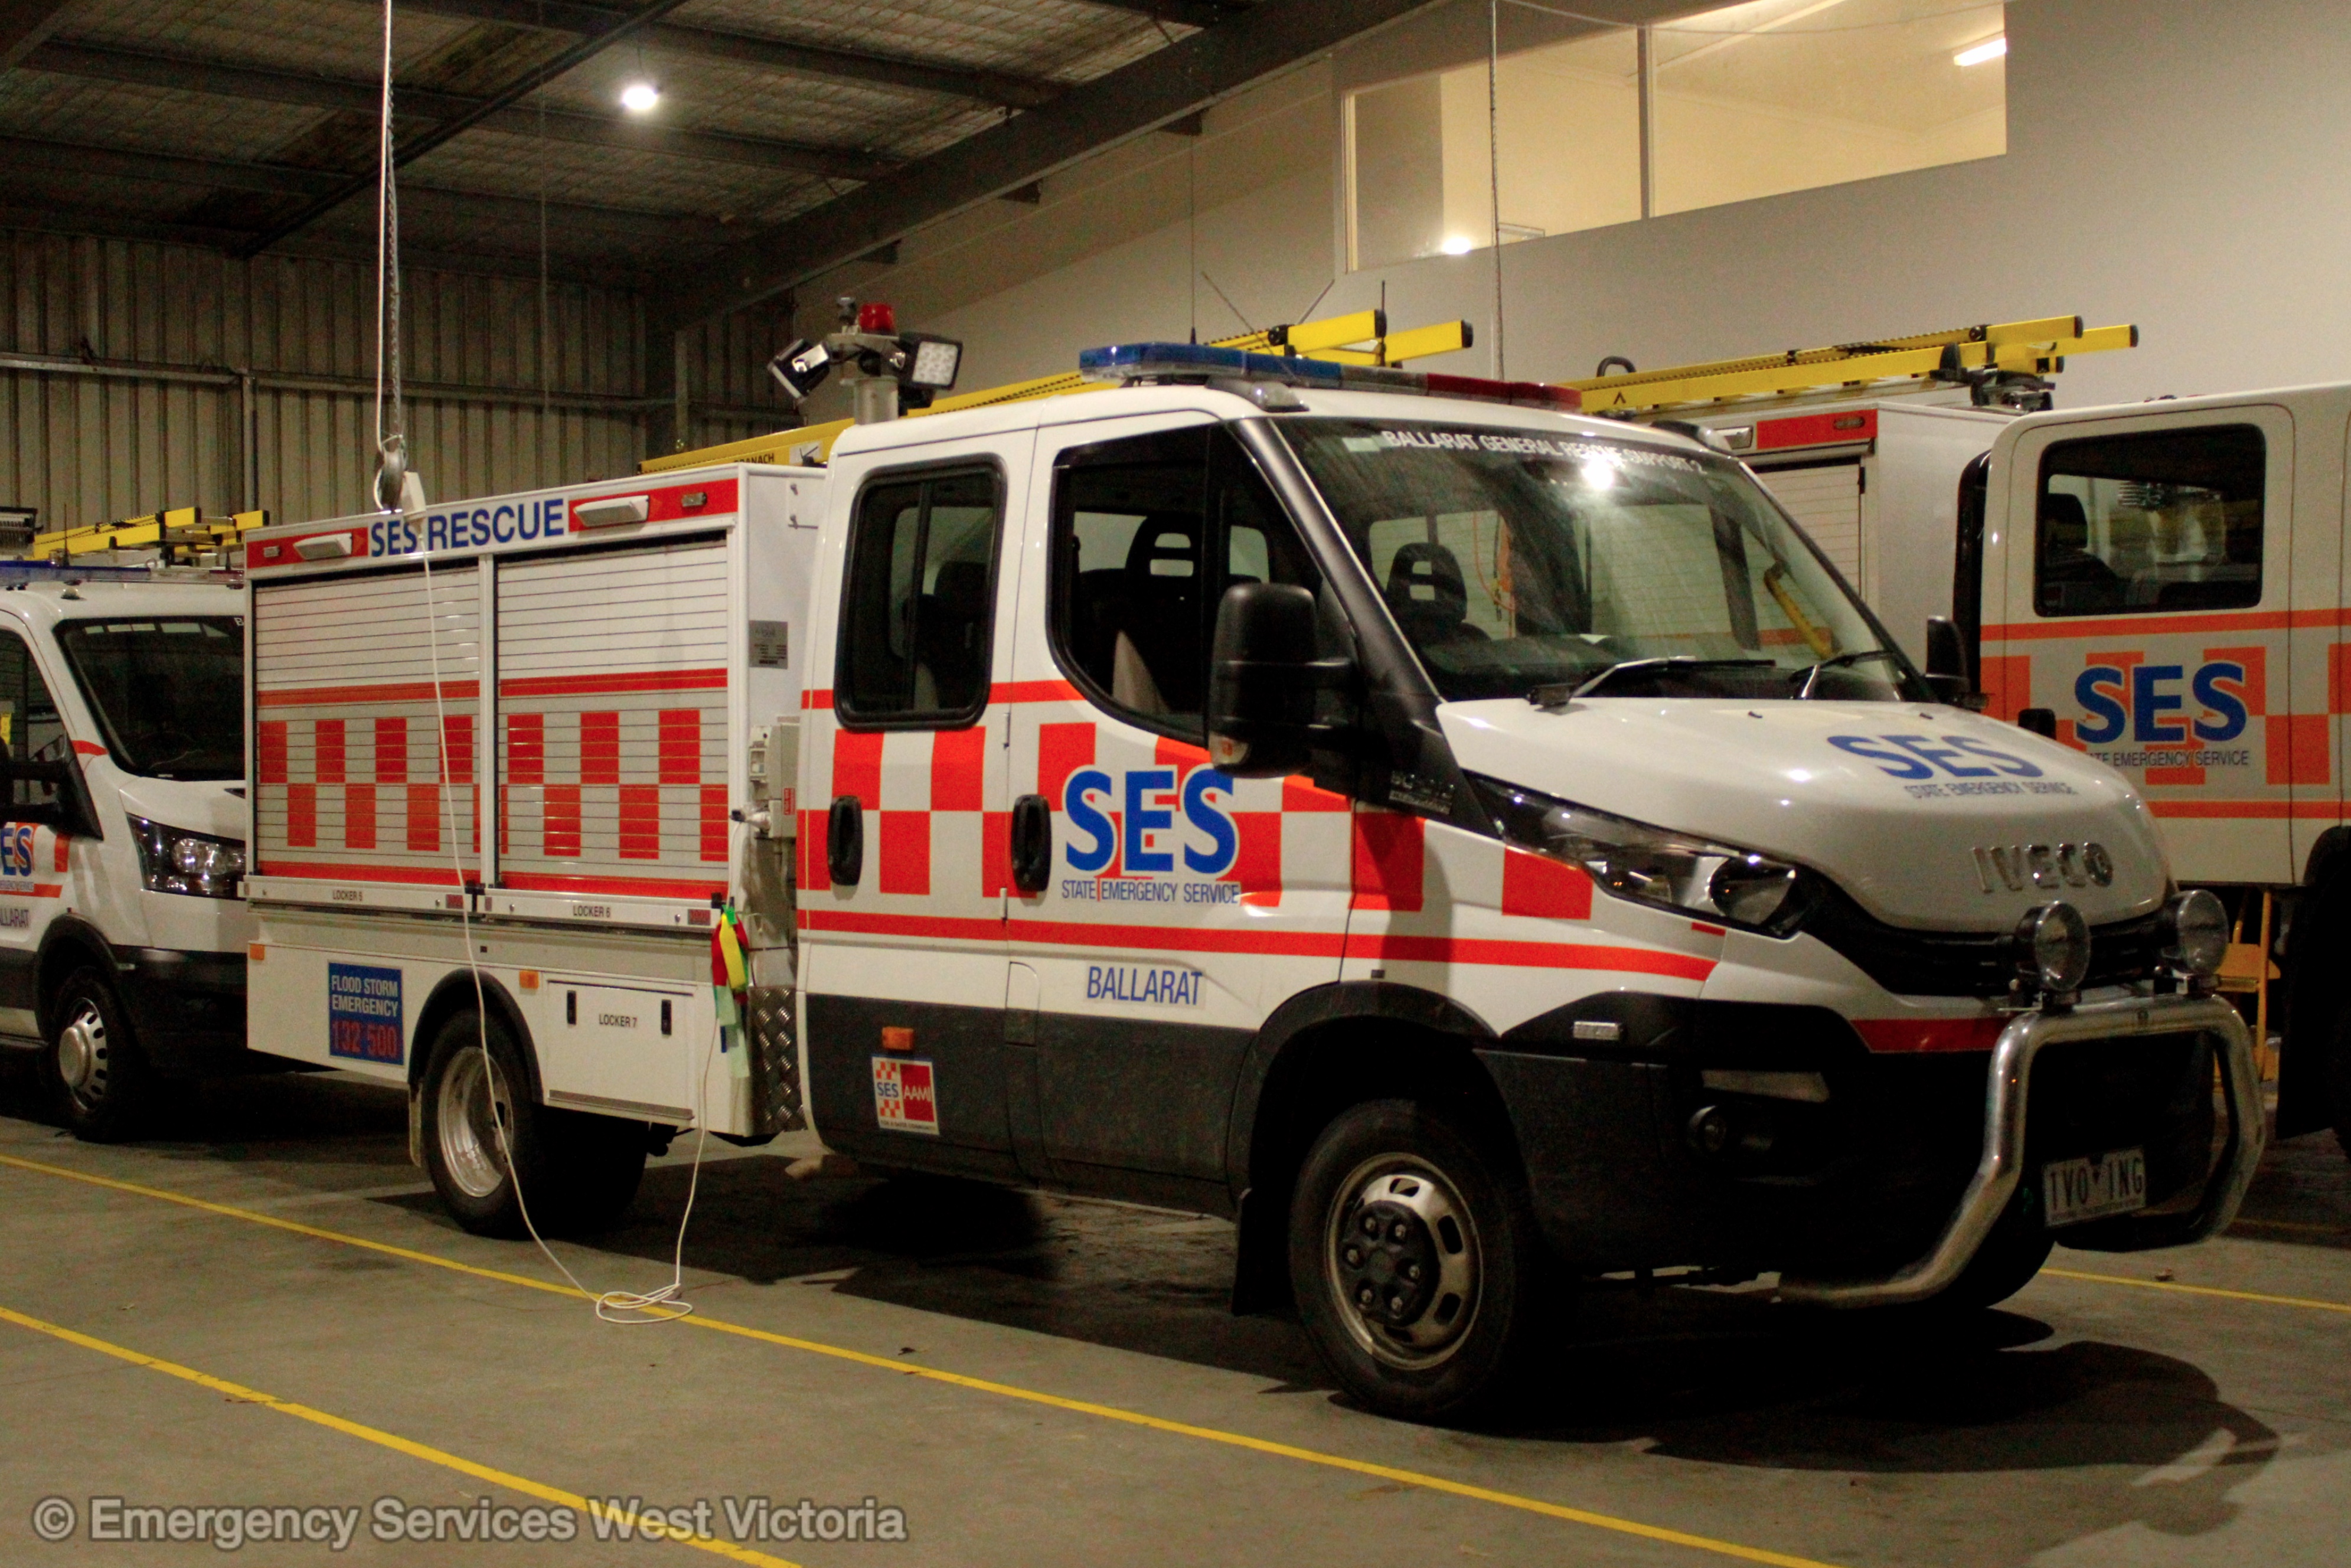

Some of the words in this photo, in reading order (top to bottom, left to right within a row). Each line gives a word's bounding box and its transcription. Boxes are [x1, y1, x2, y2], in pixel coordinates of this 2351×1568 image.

[734, 452, 775, 464] ANACH
[1380, 430, 1479, 451] BALLARAT
[1478, 435, 1564, 456] GENERAL
[1557, 442, 1626, 468] RESCUE
[1622, 449, 1694, 472] SUPPORT
[371, 520, 417, 557] SES
[427, 498, 564, 551] RESCUE
[2075, 662, 2247, 744] SES
[1826, 734, 2044, 779] SES
[2113, 751, 2191, 767] EMERGENCY
[2195, 750, 2250, 766] SERVICE
[1065, 769, 1236, 874] SES
[0, 827, 32, 877] ES
[1970, 842, 2114, 894] IVECO
[332, 890, 357, 901] LOCKER
[1062, 879, 1096, 900] STATE
[1101, 880, 1178, 902] EMERGENCY
[1183, 882, 1239, 904] SERVICE
[0, 907, 29, 929] LLARAT
[573, 904, 604, 917] LOCKER
[606, 907, 611, 918] 6
[331, 975, 362, 994] FLOOD
[364, 978, 399, 998] STORM
[1086, 966, 1204, 1005] BALLARAT
[332, 994, 399, 1018] EMERGENCY
[599, 1014, 631, 1028] LOCKER
[632, 1017, 638, 1028] 7
[332, 1020, 361, 1053] 132
[367, 1022, 400, 1059] 500
[877, 1082, 900, 1098] SES
[903, 1084, 933, 1102] AAMI
